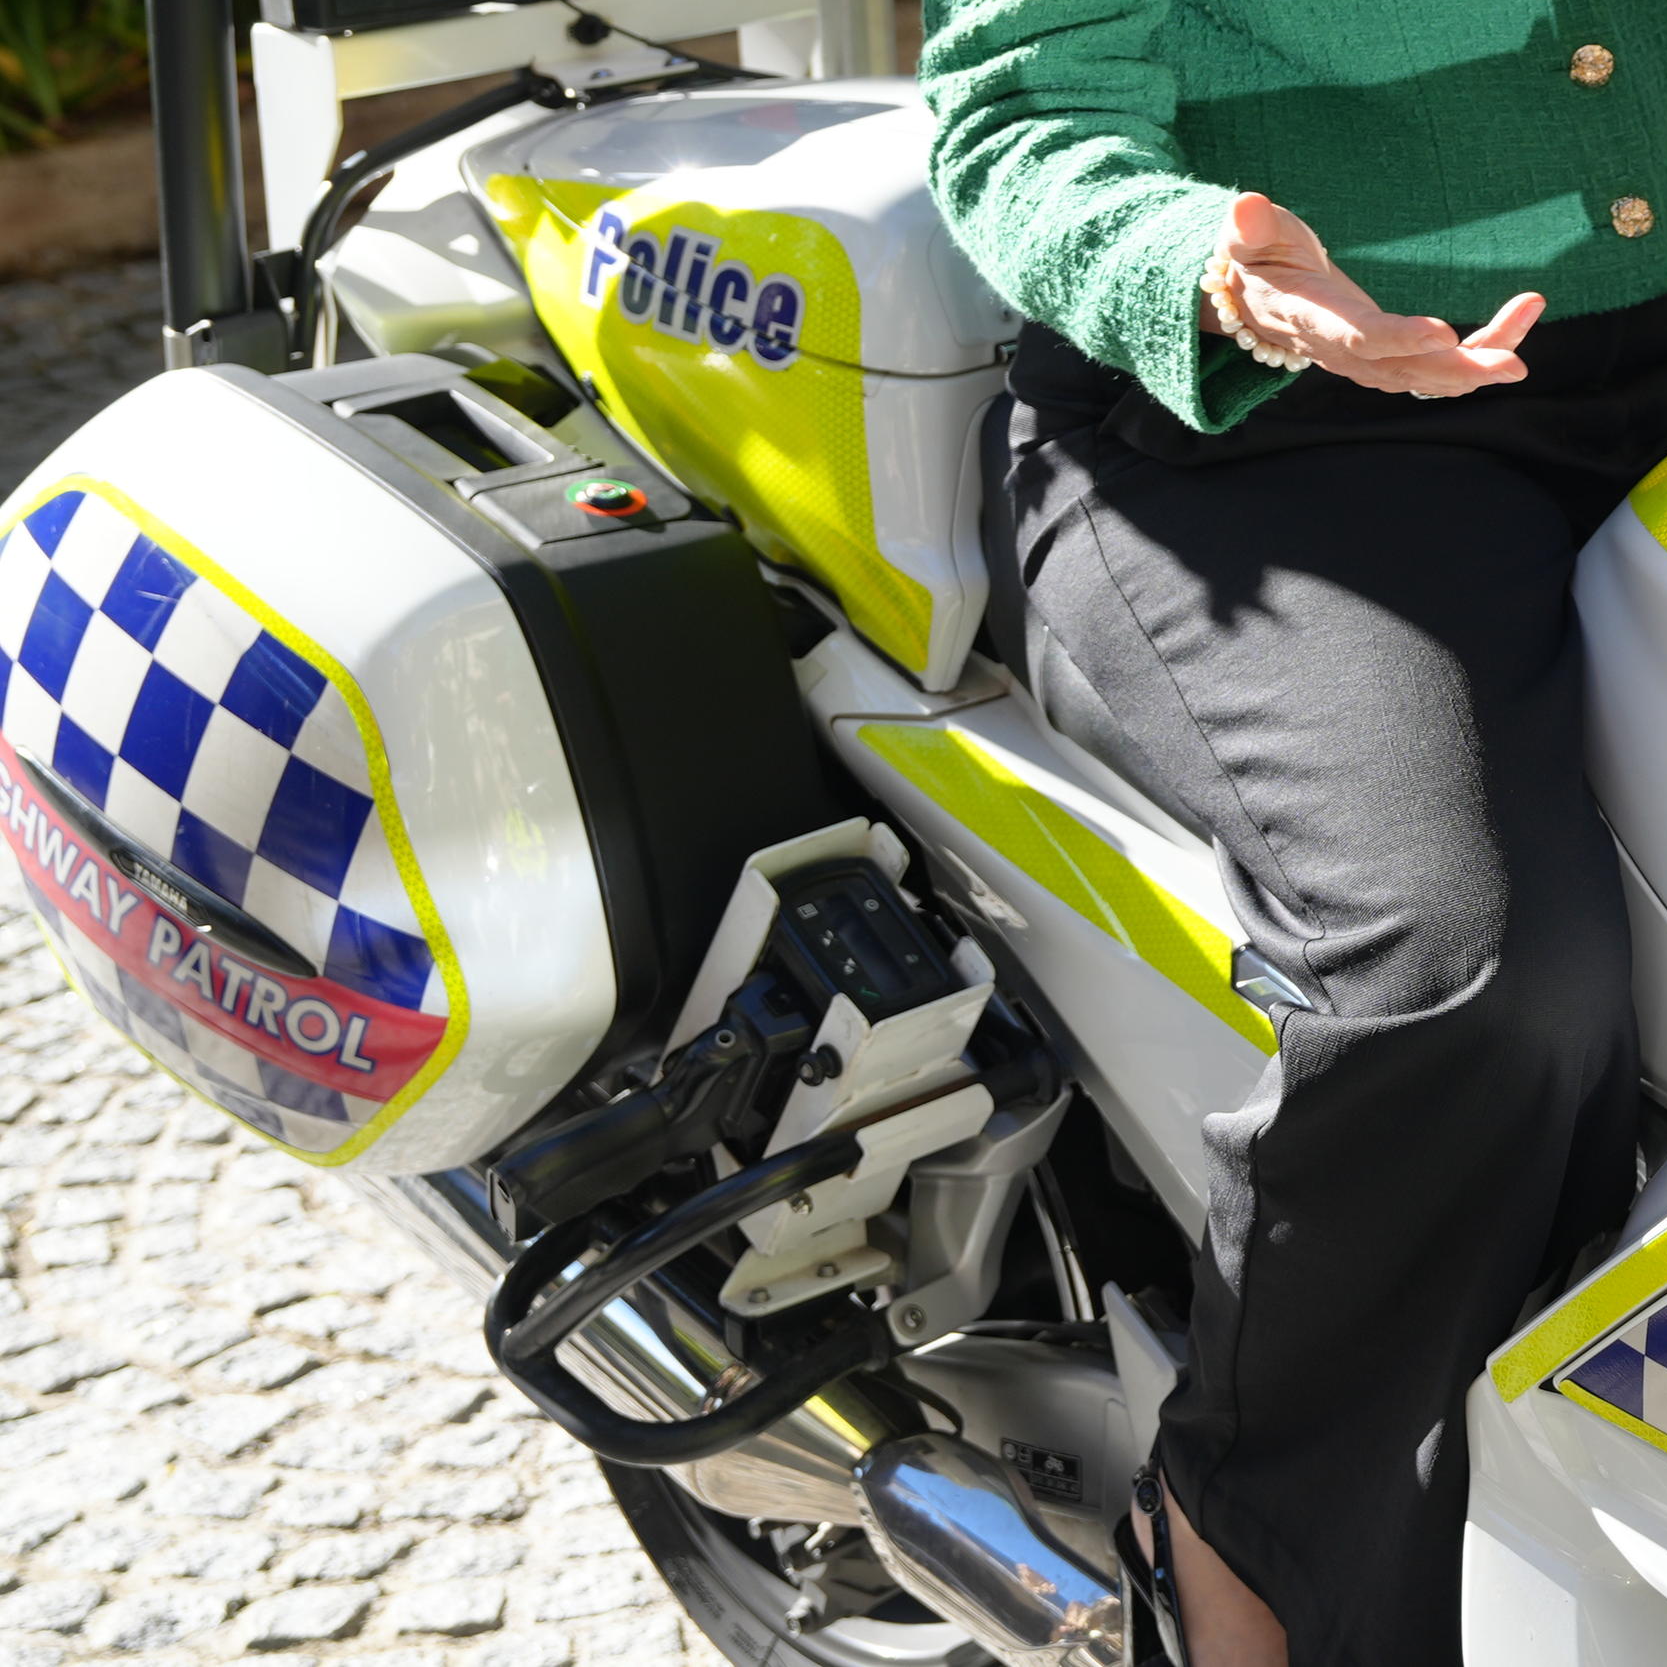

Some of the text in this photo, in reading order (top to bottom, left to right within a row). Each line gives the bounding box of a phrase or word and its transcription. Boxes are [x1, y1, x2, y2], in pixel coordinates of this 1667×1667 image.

[585, 209, 802, 364] Police
[132, 861, 190, 912] YAMAHA
[148, 915, 376, 1073] PATROL
